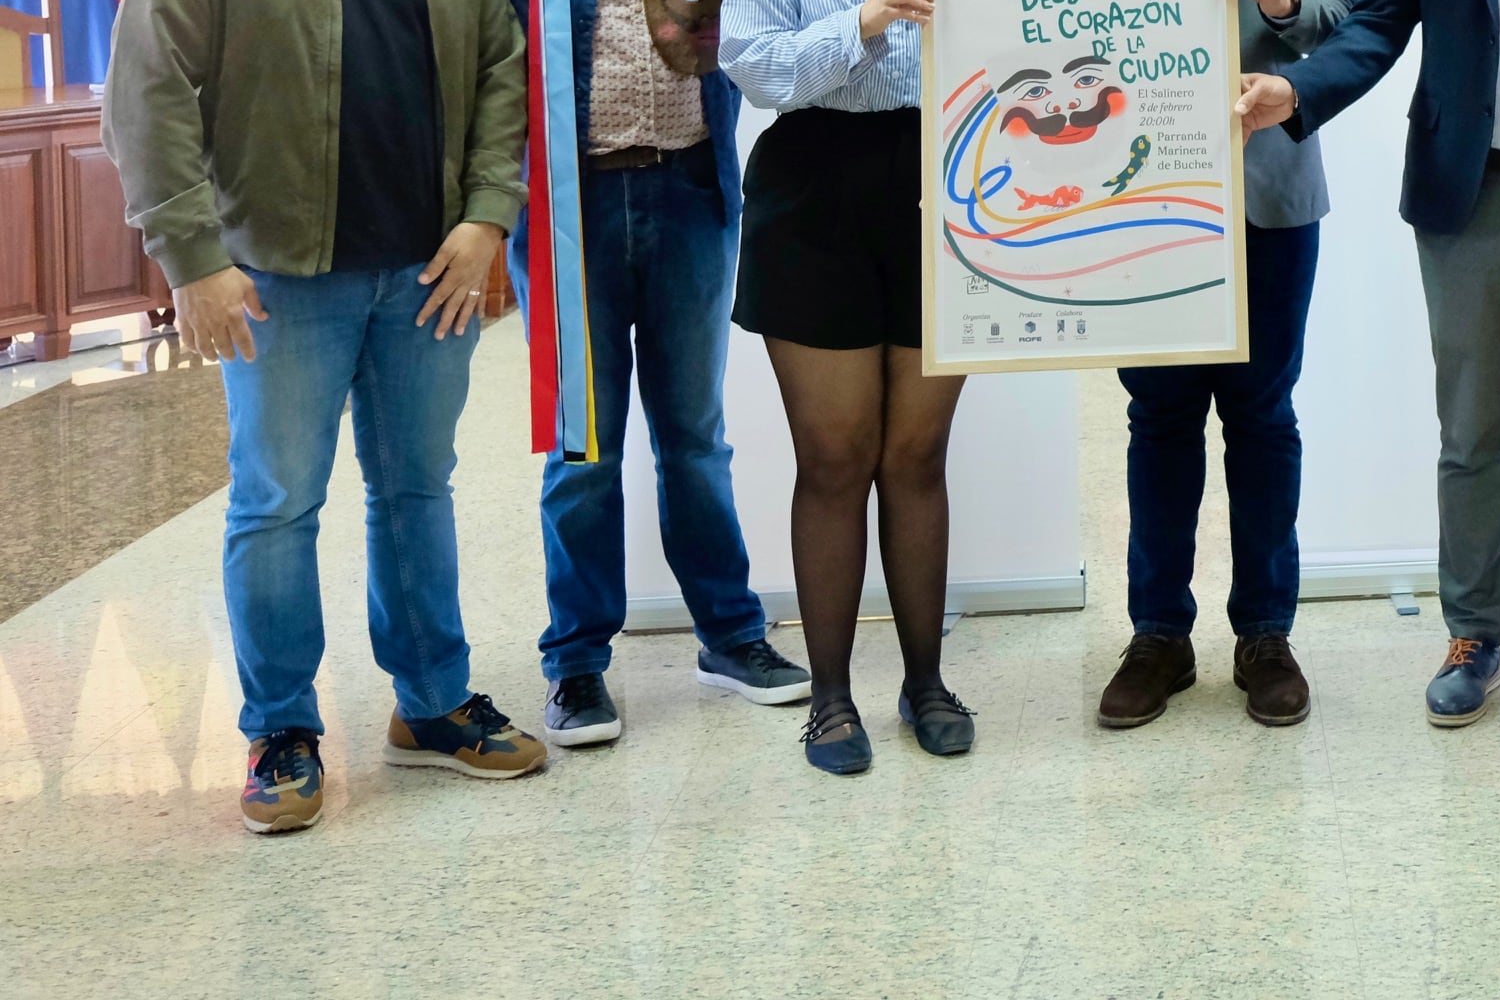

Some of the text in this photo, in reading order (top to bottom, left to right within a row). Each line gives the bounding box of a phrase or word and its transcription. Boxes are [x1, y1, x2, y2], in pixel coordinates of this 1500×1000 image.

[1021, 19, 1052, 43] EL
[1092, 35, 1145, 60] DE LA
[1118, 47, 1211, 84] CIUDAD
[1138, 88, 1194, 98] El Salinero
[1139, 102, 1192, 114] 8 de febrero
[1139, 116, 1175, 126] 20:00h
[1157, 131, 1207, 141] Parranda
[1157, 145, 1207, 156] Marinera
[1157, 160, 1213, 170] de Buches
